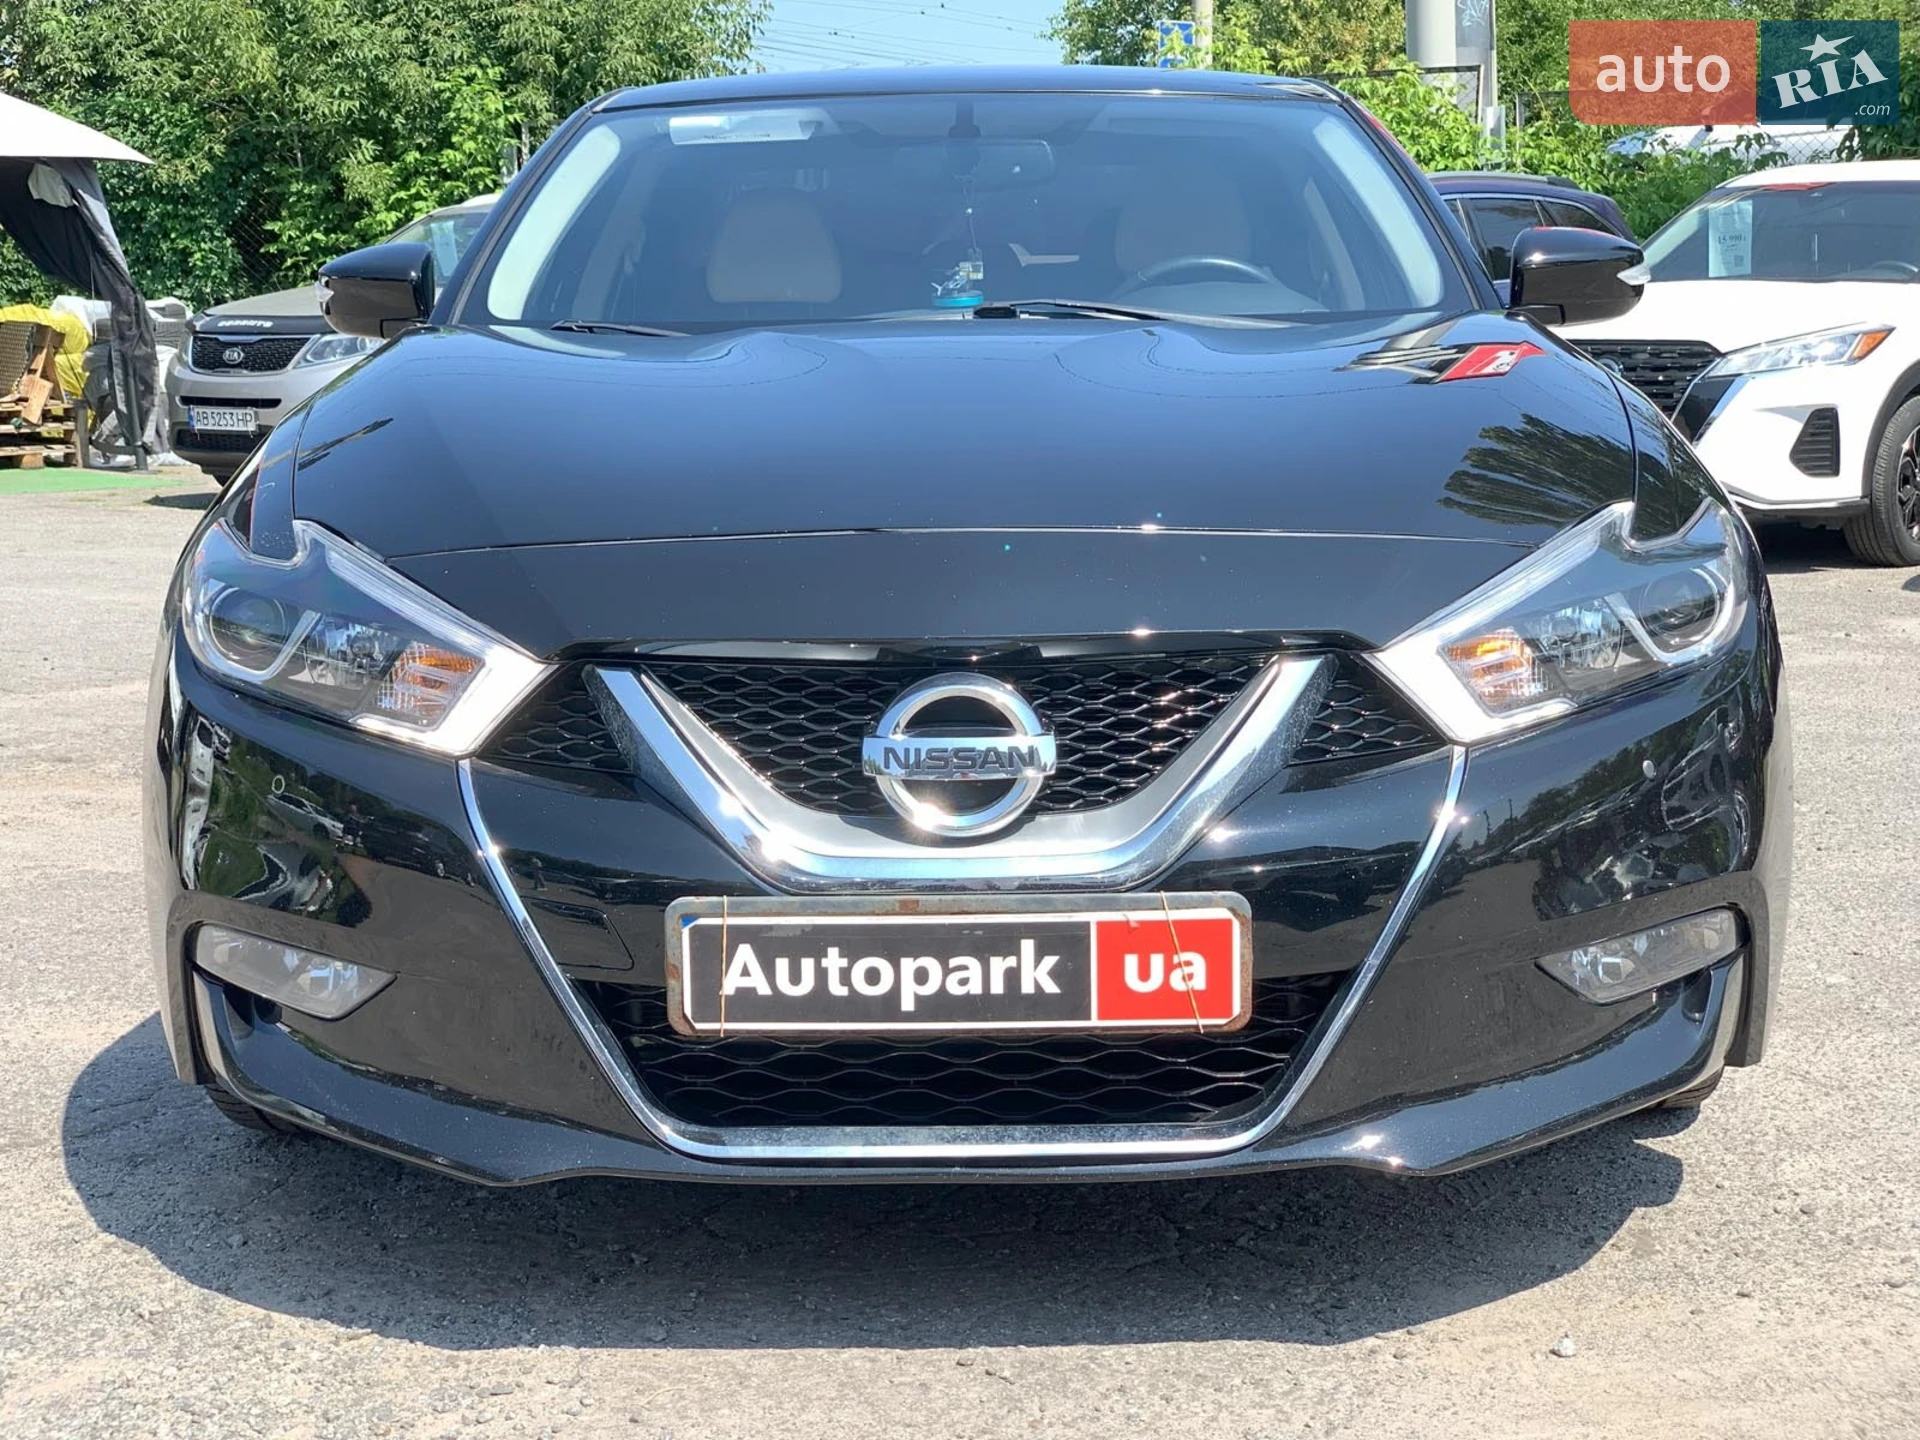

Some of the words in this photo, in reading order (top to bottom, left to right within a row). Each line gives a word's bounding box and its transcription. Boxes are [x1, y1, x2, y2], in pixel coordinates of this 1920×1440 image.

[224, 350, 239, 359] KIA
[196, 411, 210, 426] AB
[210, 411, 235, 427] 5253
[236, 412, 253, 428] HP
[883, 745, 1035, 770] NISSAN
[719, 938, 1062, 1012] Autopark
[1123, 951, 1207, 993] ua
